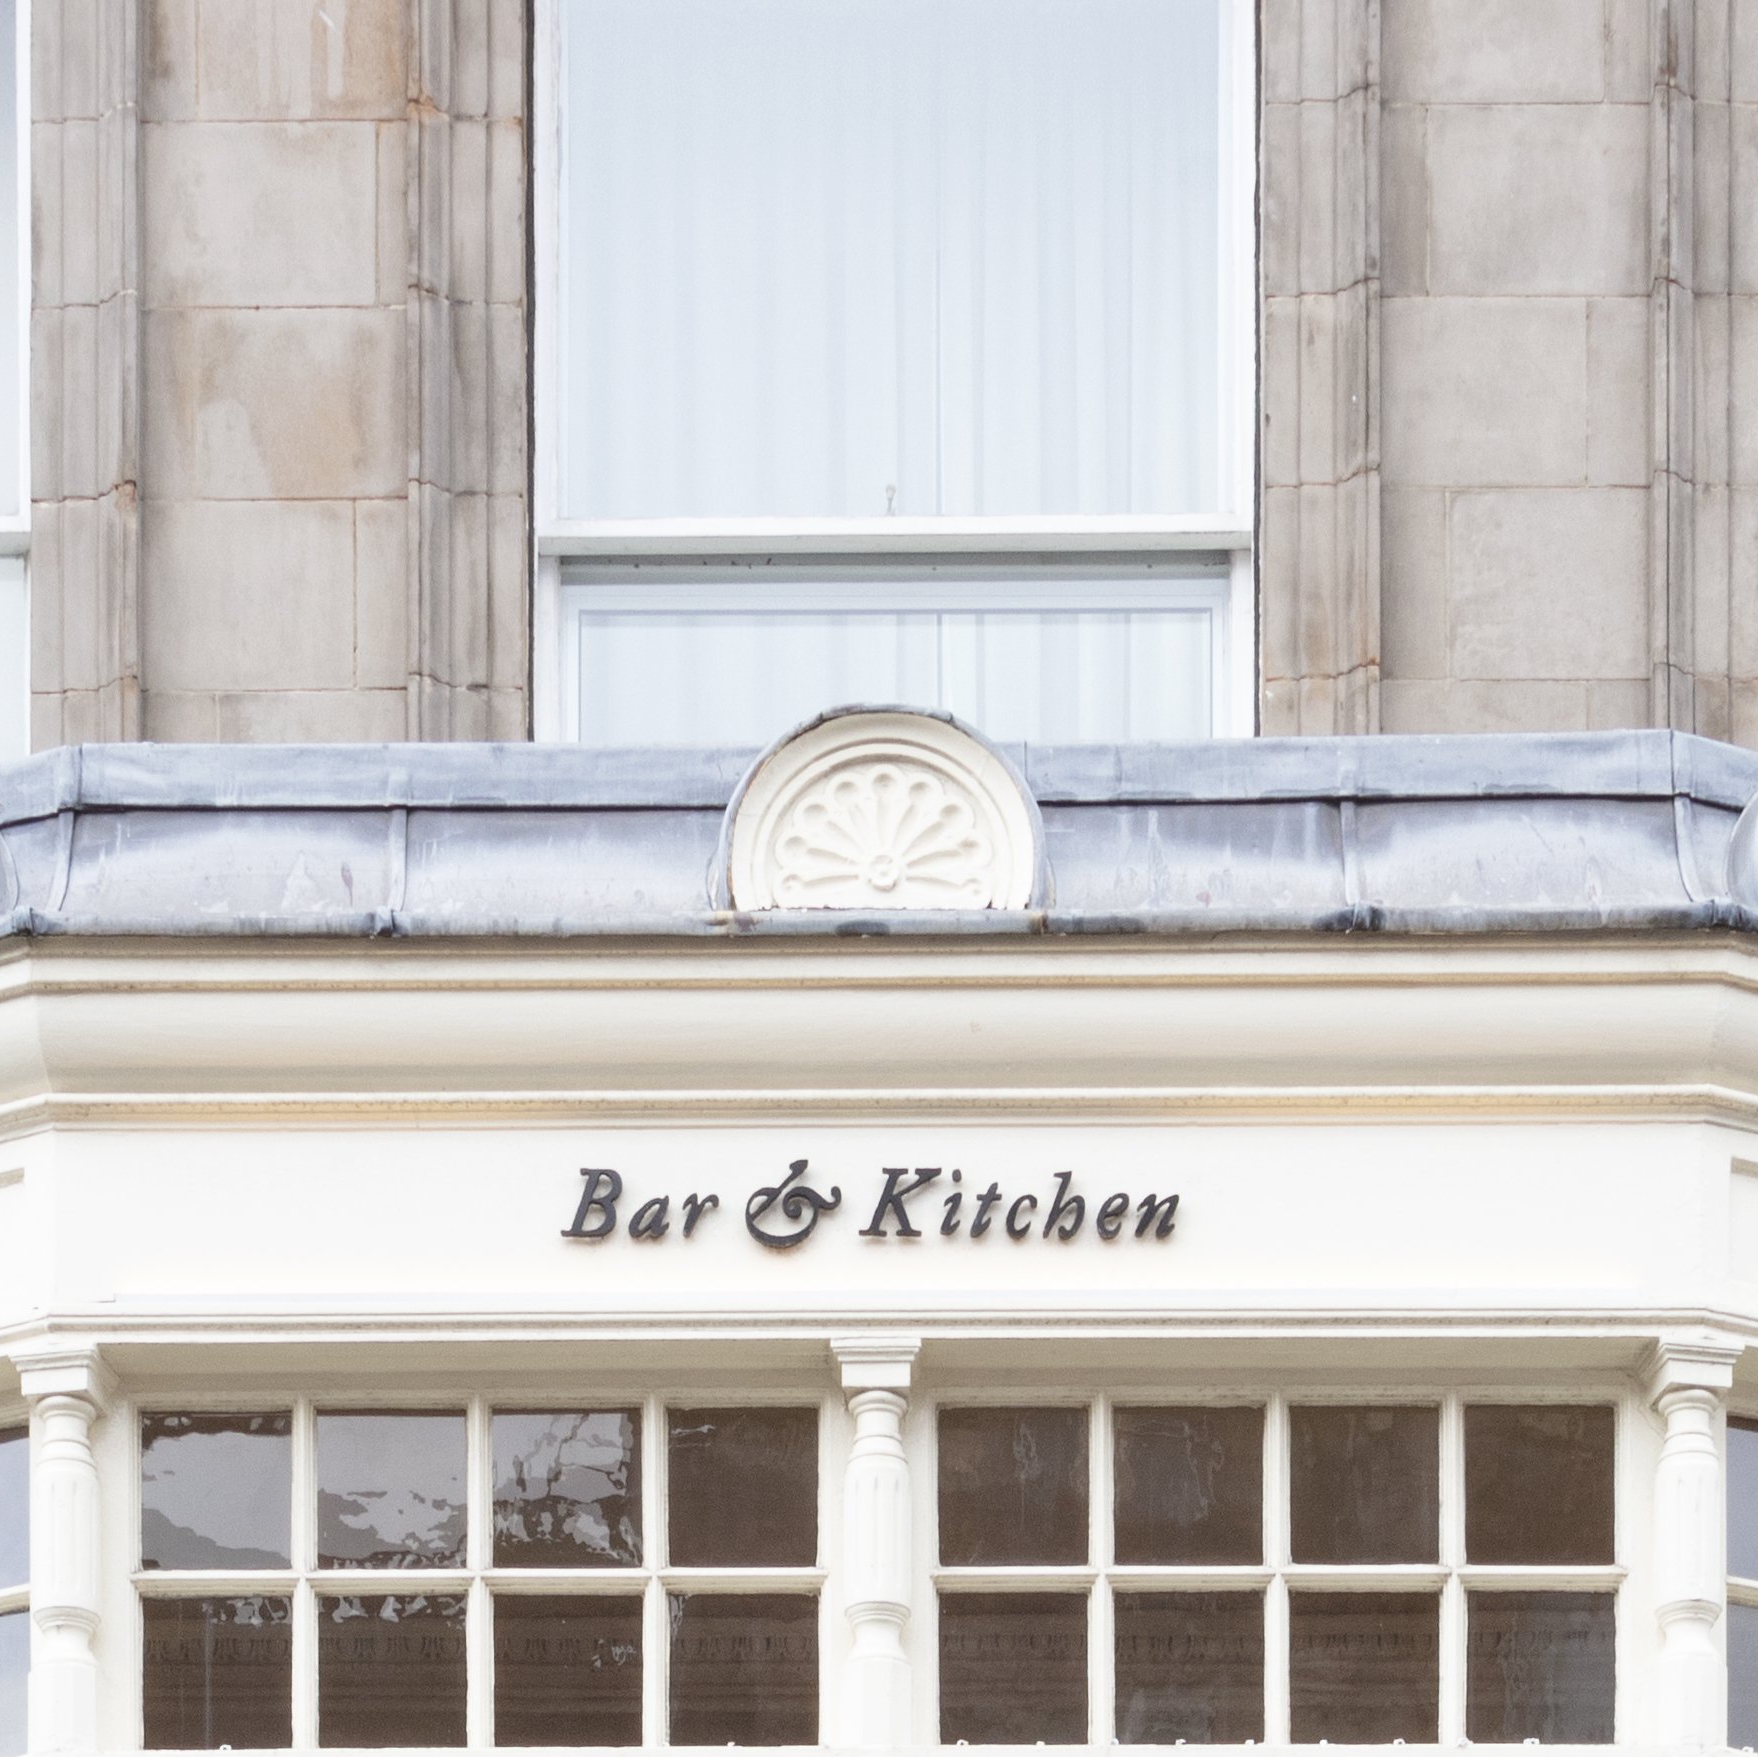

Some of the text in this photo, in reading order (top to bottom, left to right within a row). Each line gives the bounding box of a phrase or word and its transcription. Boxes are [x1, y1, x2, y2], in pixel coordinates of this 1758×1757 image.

[560, 1158, 1180, 1249] Bar & Kitchen
